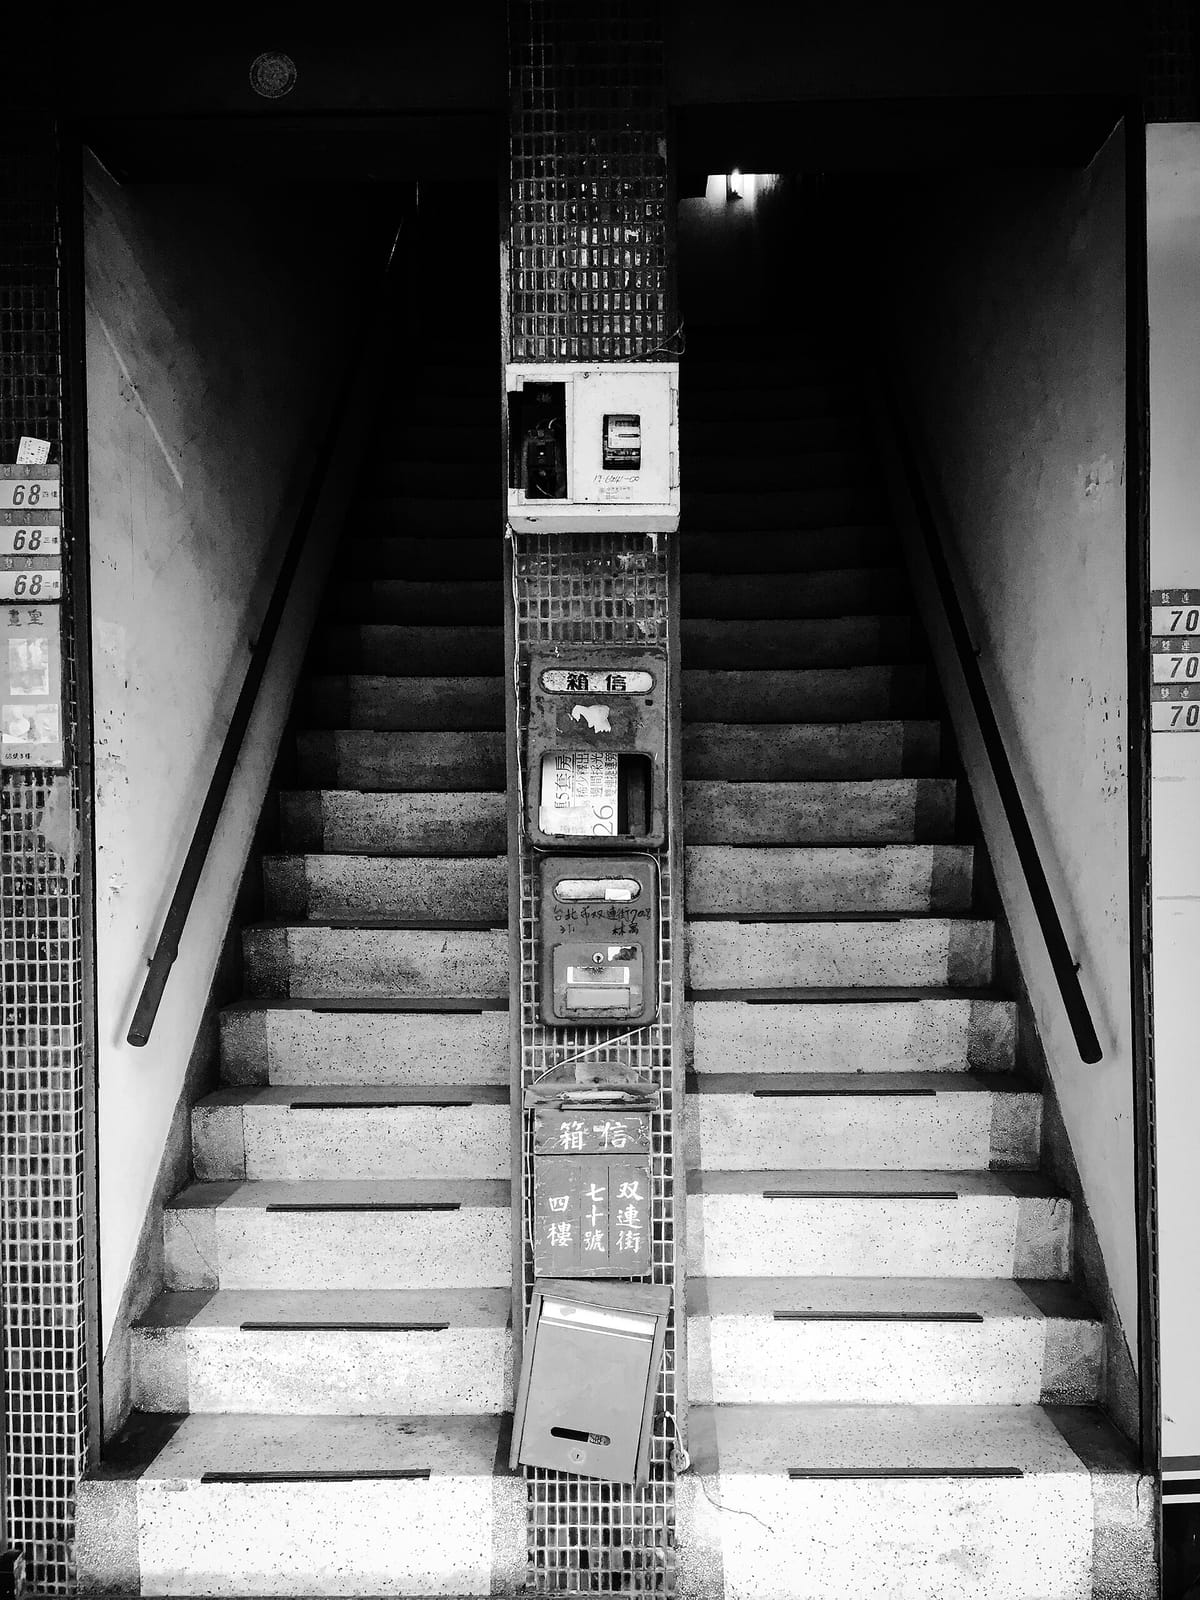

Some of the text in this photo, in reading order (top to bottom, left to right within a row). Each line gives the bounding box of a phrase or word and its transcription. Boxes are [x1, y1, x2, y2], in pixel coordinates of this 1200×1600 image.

[12, 484, 41, 506] 68
[13, 530, 42, 550] 68
[14, 574, 43, 595] 68
[1170, 609, 1199, 632] 70
[1170, 656, 1199, 678] 70
[1170, 704, 1199, 727] 70
[547, 1195, 573, 1247] 四樓
[583, 1183, 606, 1252] 七十號
[615, 1181, 644, 1253] 双連街
